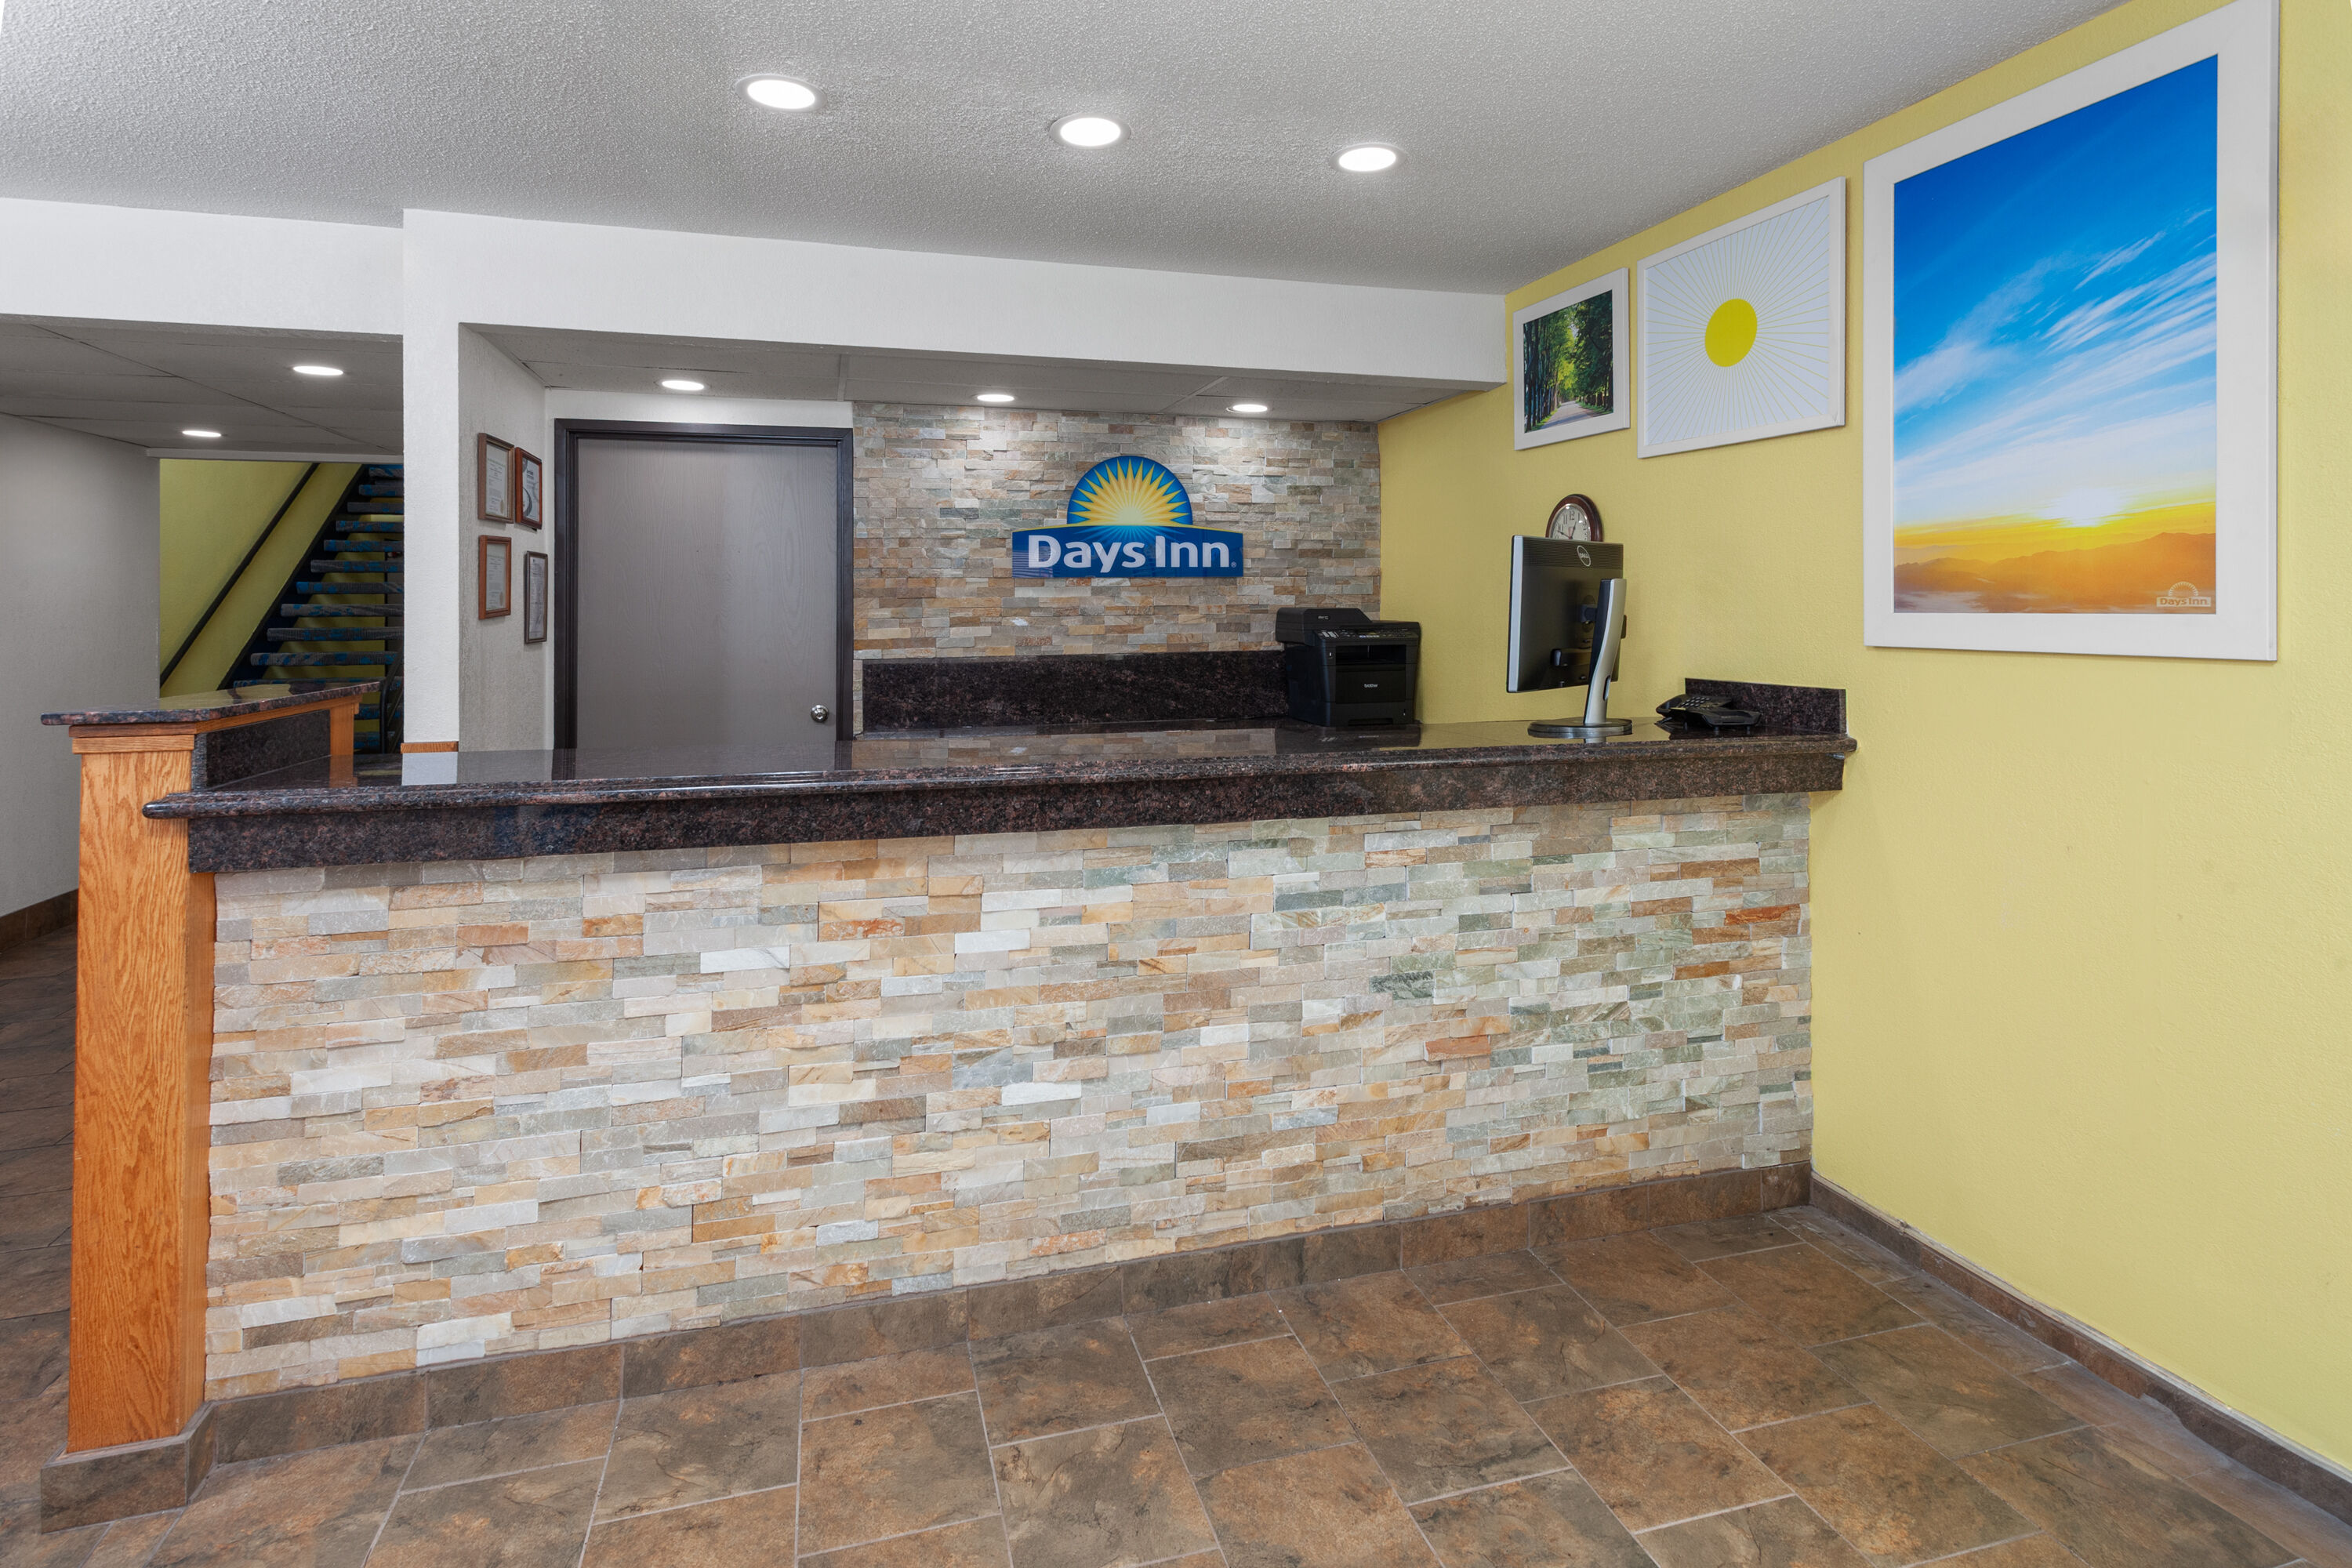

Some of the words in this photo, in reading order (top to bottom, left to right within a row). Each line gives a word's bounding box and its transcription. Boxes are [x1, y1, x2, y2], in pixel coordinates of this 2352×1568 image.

[1028, 535, 1145, 573] Days
[1155, 535, 1230, 568] Inn
[2160, 597, 2187, 606] Days
